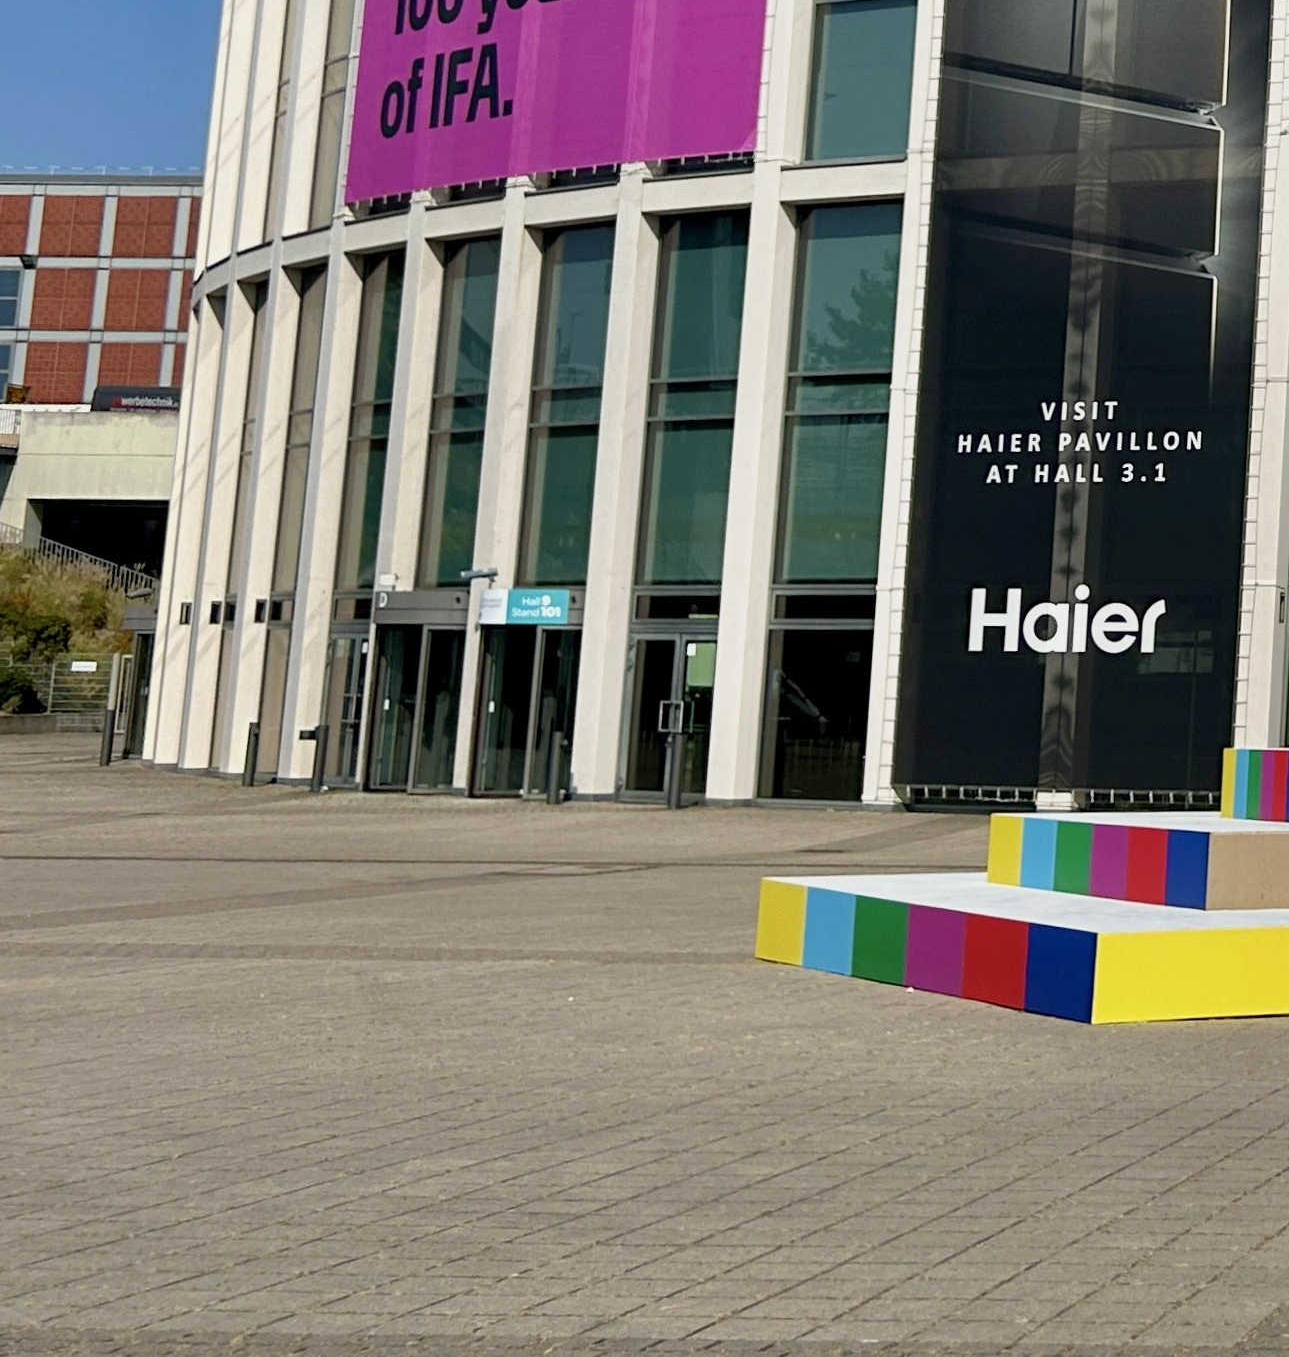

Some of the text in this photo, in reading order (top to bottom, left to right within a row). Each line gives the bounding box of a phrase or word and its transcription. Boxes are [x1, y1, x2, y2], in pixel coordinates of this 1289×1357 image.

[380, 43, 513, 138] of IFA.
[1041, 401, 1118, 421] VISIT
[957, 431, 1203, 453] HAIER PAVILLON
[985, 463, 1166, 484] AT HALL 3.1
[511, 606, 561, 617] Stand 101
[521, 596, 541, 606] Hall
[968, 584, 1166, 654] Haier
